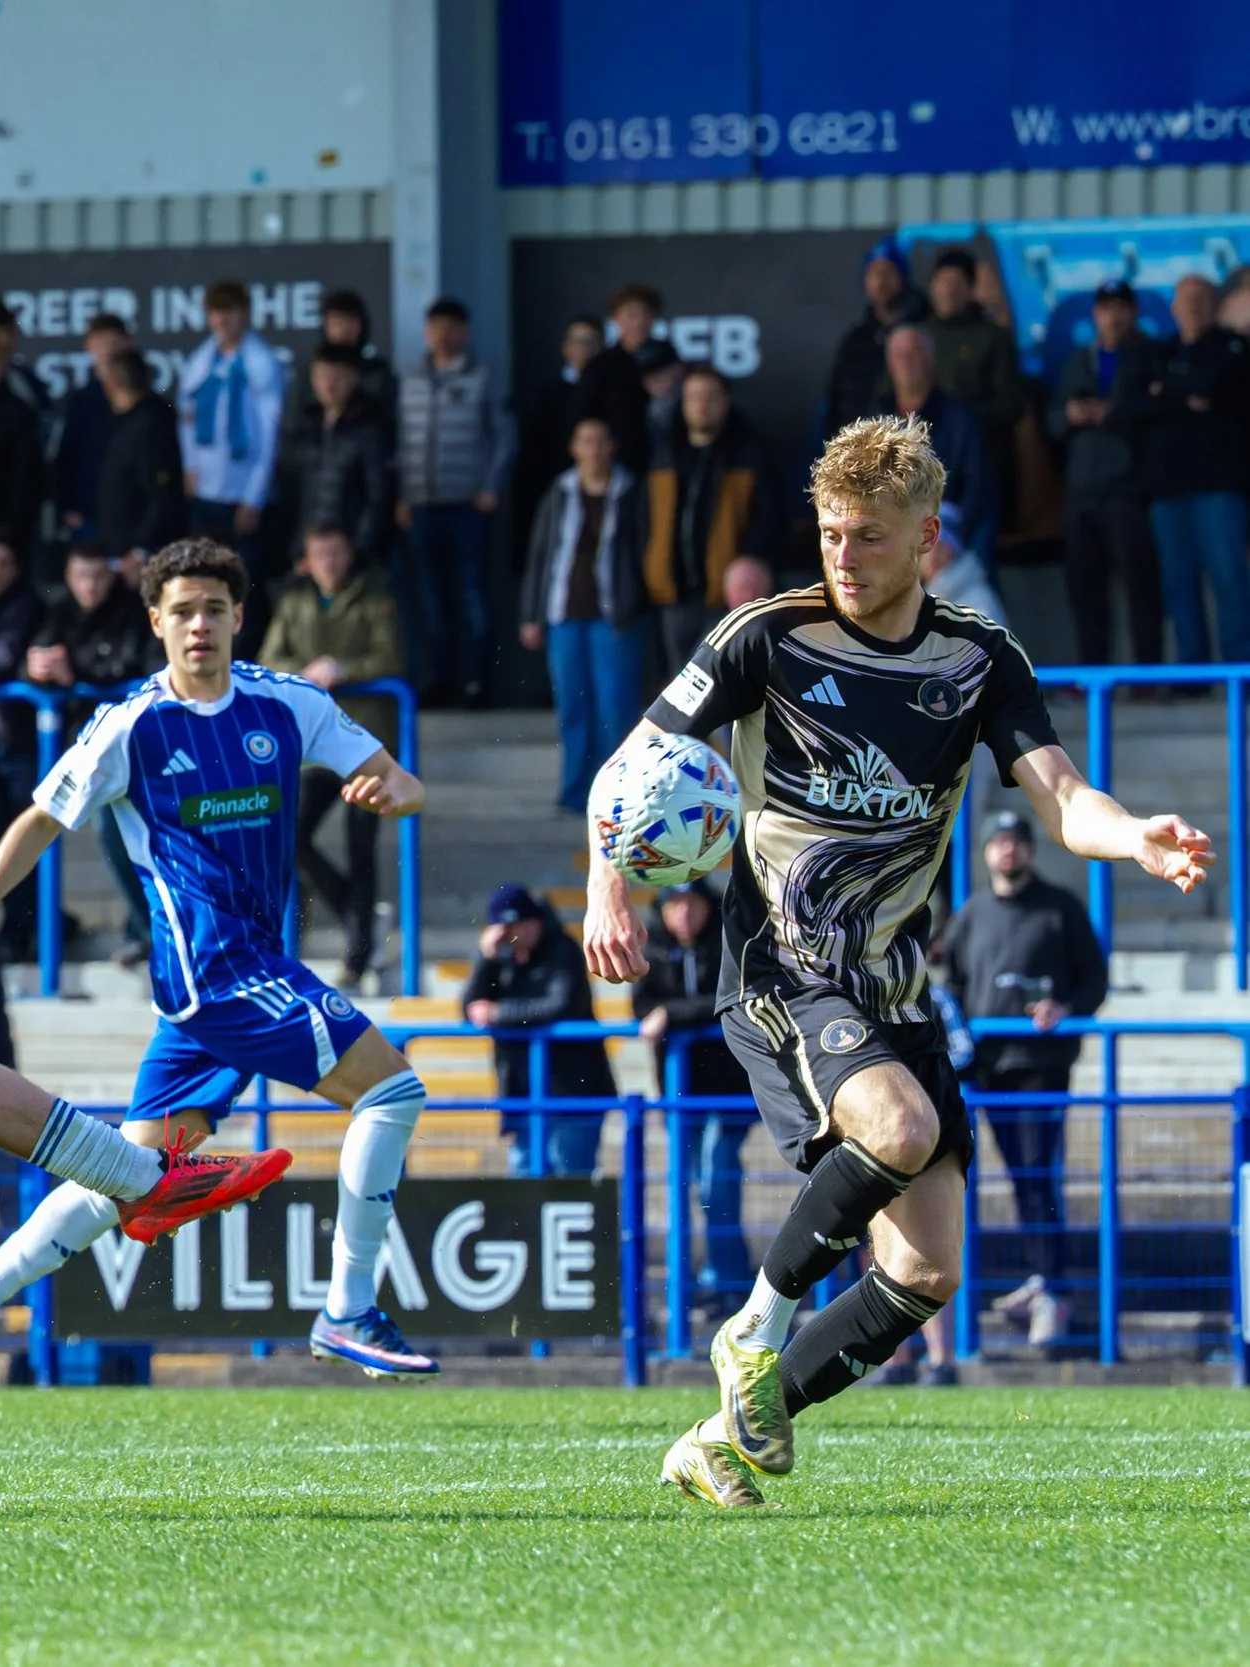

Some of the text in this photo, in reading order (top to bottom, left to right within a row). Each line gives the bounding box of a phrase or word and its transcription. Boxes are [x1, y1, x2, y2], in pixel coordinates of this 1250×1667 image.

[564, 116, 672, 162] 0161
[688, 112, 780, 159] 330
[788, 109, 900, 156] 6821
[153, 285, 207, 332] IN
[246, 282, 322, 330] HE
[199, 792, 270, 819] Pinnacle
[805, 774, 934, 820] BUXTON
[91, 1200, 597, 1313] VILLAGE
